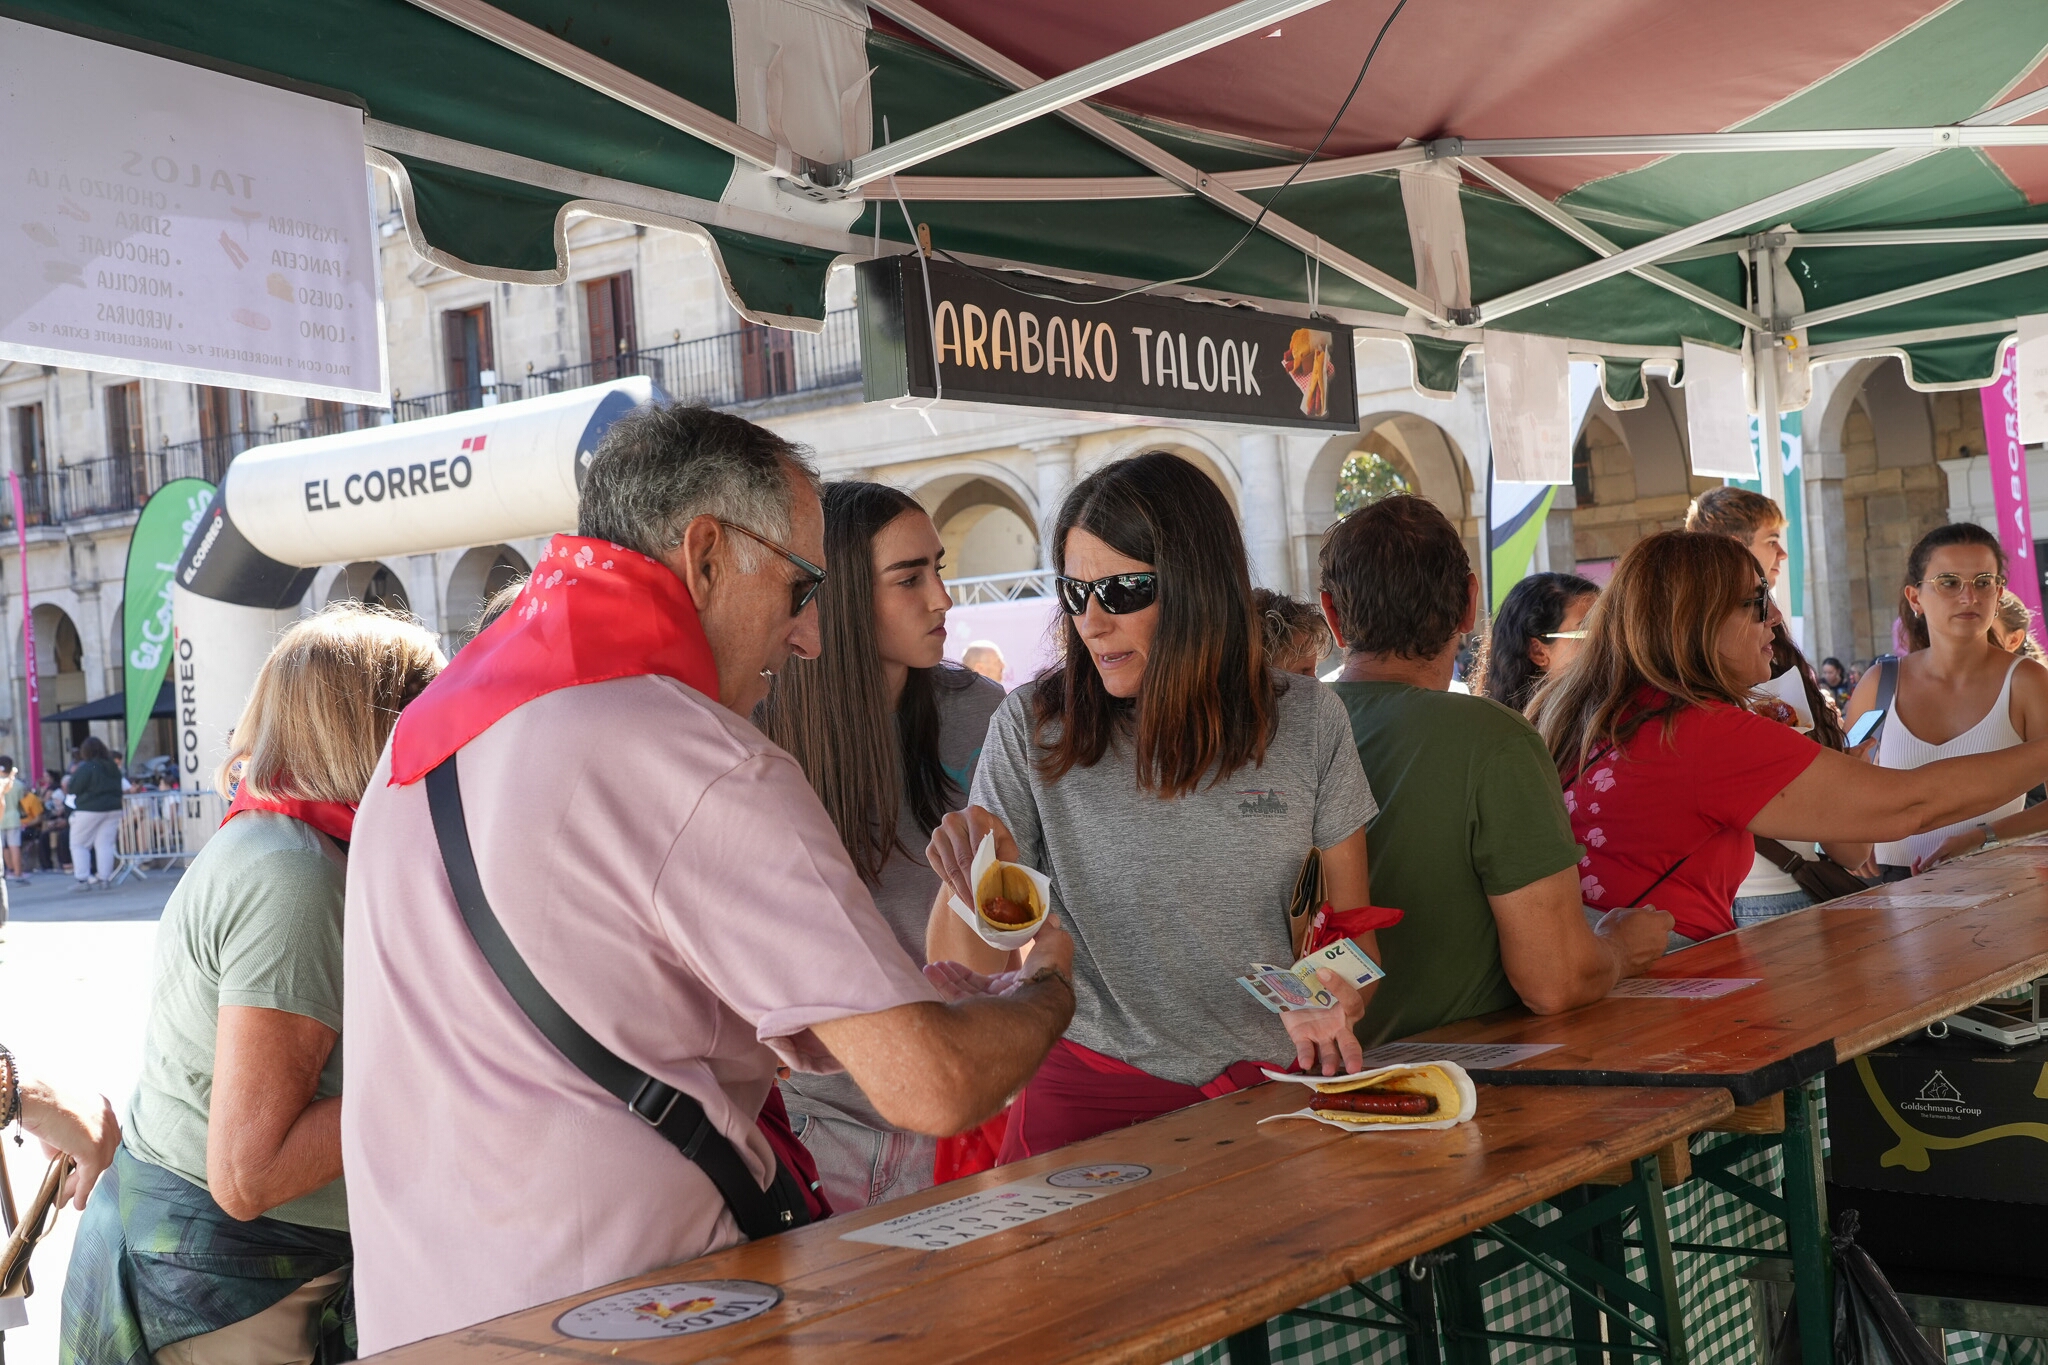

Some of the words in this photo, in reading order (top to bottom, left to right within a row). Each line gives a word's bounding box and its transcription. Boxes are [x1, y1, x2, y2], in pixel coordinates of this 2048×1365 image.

[934, 300, 1118, 383] ARABAKO
[1132, 327, 1262, 397] TALOAK
[304, 478, 341, 512] EL
[344, 455, 472, 506] CORREO
[2001, 354, 2027, 559] LABORAL
[183, 566, 198, 585] EL
[192, 515, 223, 569] CORREO
[130, 641, 163, 670] El
[179, 639, 200, 773] CORREO
[1325, 945, 1346, 960] 20
[1900, 1102, 1954, 1113] Goldschmaus
[1955, 1105, 1982, 1116] Group
[661, 1298, 769, 1333] TALOS
